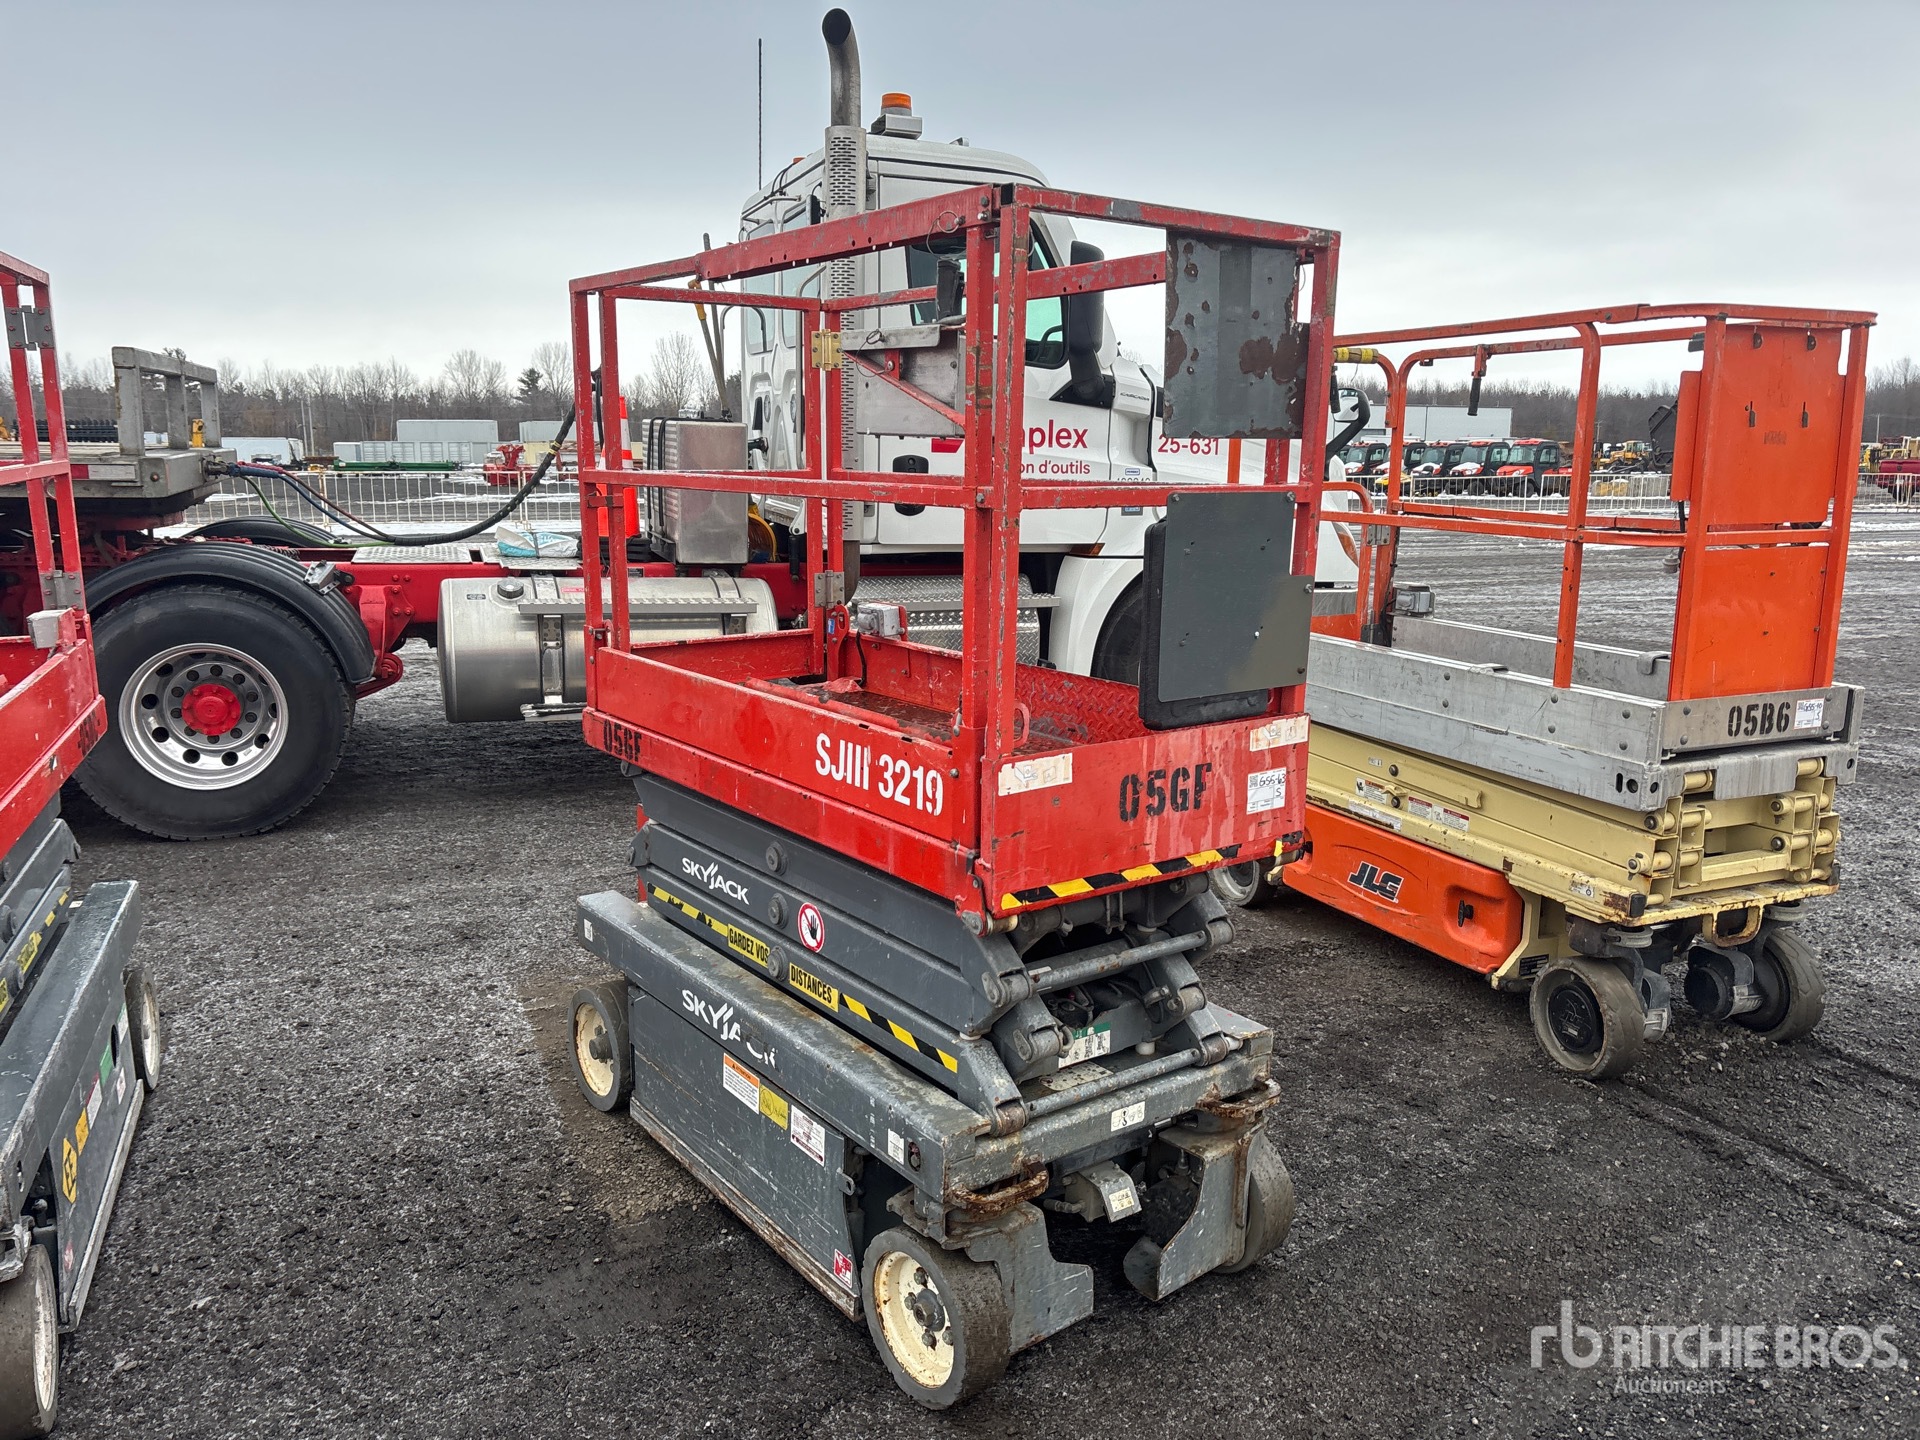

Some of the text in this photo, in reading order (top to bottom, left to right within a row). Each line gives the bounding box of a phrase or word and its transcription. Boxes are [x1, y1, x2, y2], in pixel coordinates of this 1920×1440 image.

[1022, 419, 1089, 455] plex
[1157, 433, 1219, 456] 25-631
[1038, 459, 1091, 475] d'outils
[603, 717, 643, 763] 05GF
[1727, 701, 1791, 737] 05B6
[877, 753, 944, 817] 3219
[1119, 762, 1213, 822] 05GF
[681, 857, 751, 906] SKYJACK
[1347, 861, 1404, 902] JLG
[728, 928, 833, 1004] GARDEZ VOS DISTANCES
